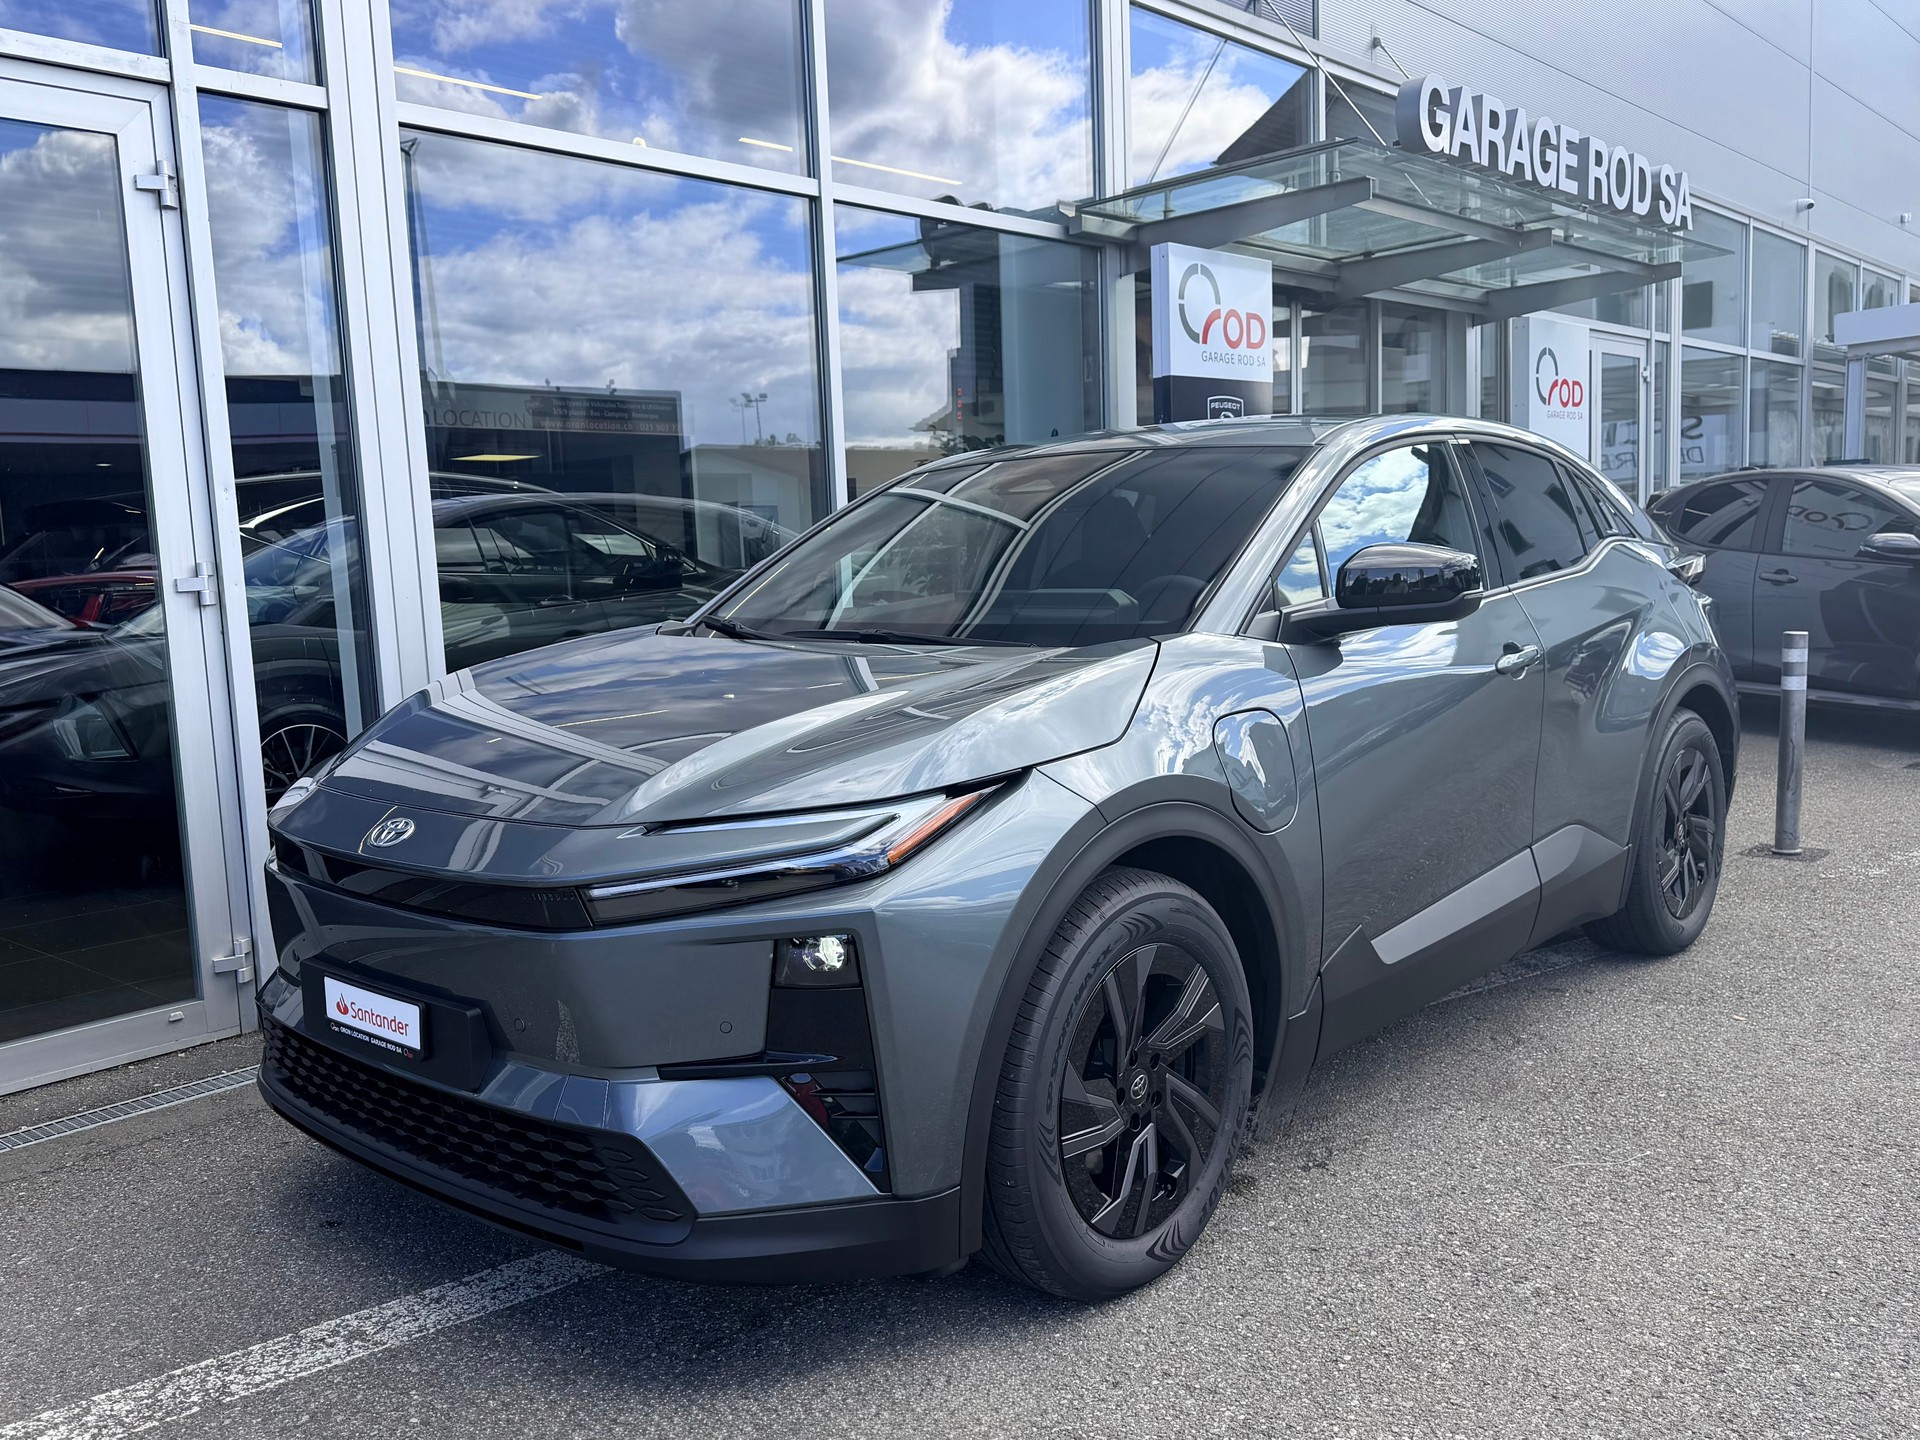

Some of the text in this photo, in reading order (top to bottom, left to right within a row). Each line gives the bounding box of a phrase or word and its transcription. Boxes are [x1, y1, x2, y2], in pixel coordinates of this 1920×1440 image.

[1420, 73, 1693, 230] GARAGE ROD SA
[1201, 350, 1266, 368] GARAGE ROD SA
[1210, 402, 1241, 410] PEUGEOT
[1547, 410, 1583, 420] GARAGE ROD SA
[434, 409, 526, 428] LOCATION
[540, 419, 632, 430] www.oronlocation.ch
[1074, 943, 1113, 1007] MAXX
[350, 1001, 409, 1037] Santander
[1199, 1105, 1246, 1226] DUNLOP
